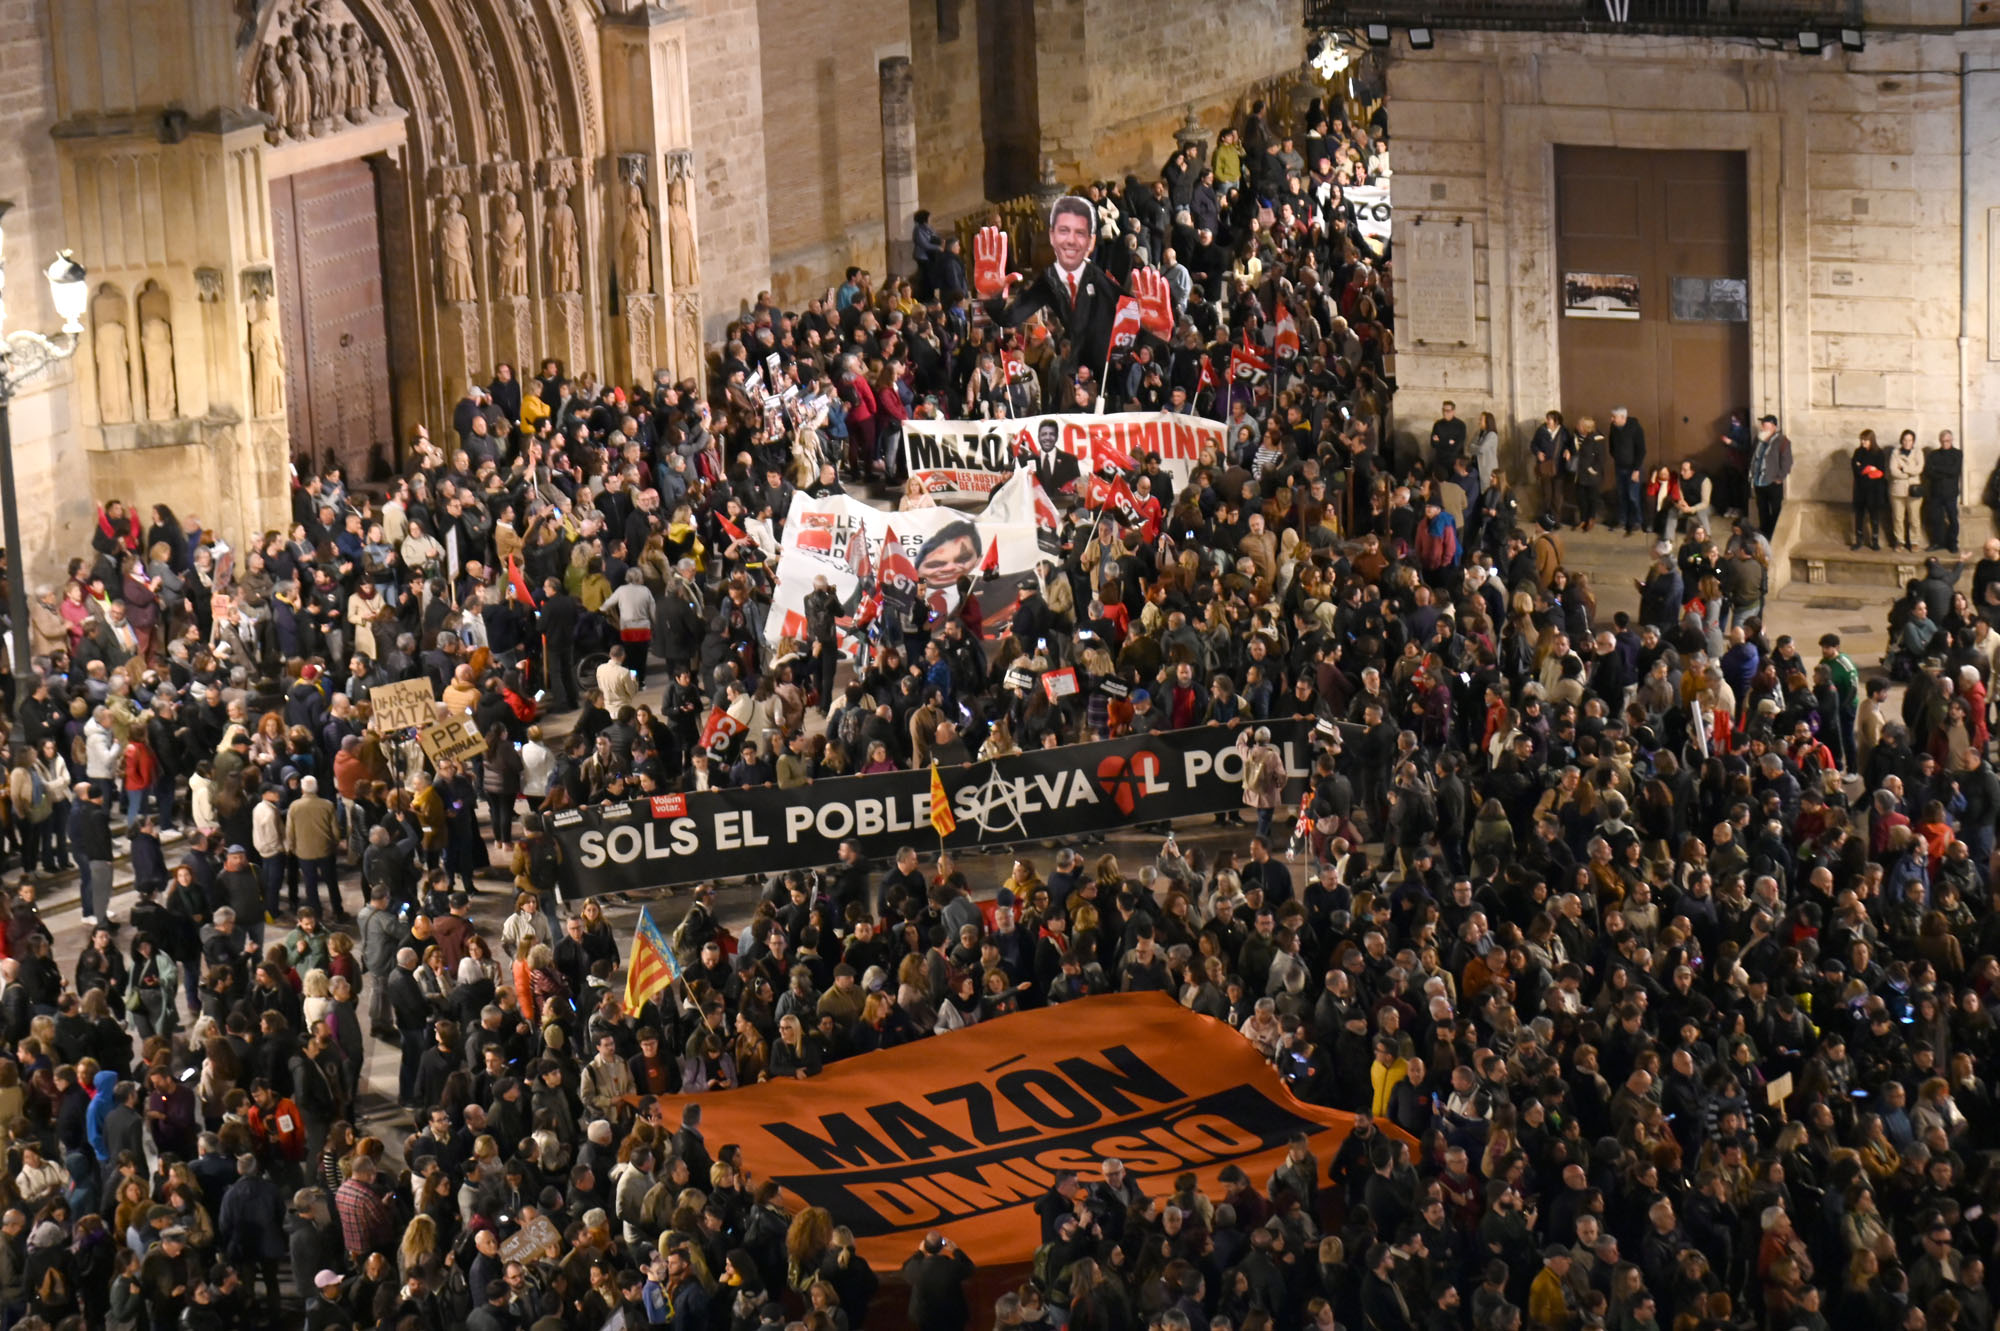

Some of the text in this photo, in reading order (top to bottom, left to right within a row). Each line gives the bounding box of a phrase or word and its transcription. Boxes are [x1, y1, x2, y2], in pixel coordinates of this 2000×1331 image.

[929, 483, 948, 492] CGT
[960, 482, 970, 491] DE
[1115, 491, 1139, 520] CGT
[883, 569, 916, 595] CGT
[377, 702, 437, 730] MATA
[431, 722, 462, 749] PP
[706, 717, 737, 761] CGT
[652, 795, 682, 804] Volem
[655, 804, 680, 813] votar.
[579, 817, 699, 868] SOLS
[714, 810, 770, 850] EL
[785, 793, 932, 843] POBLE
[761, 1045, 1188, 1170] MAZÓN
[843, 1104, 1264, 1228] DIMISSIÓ
